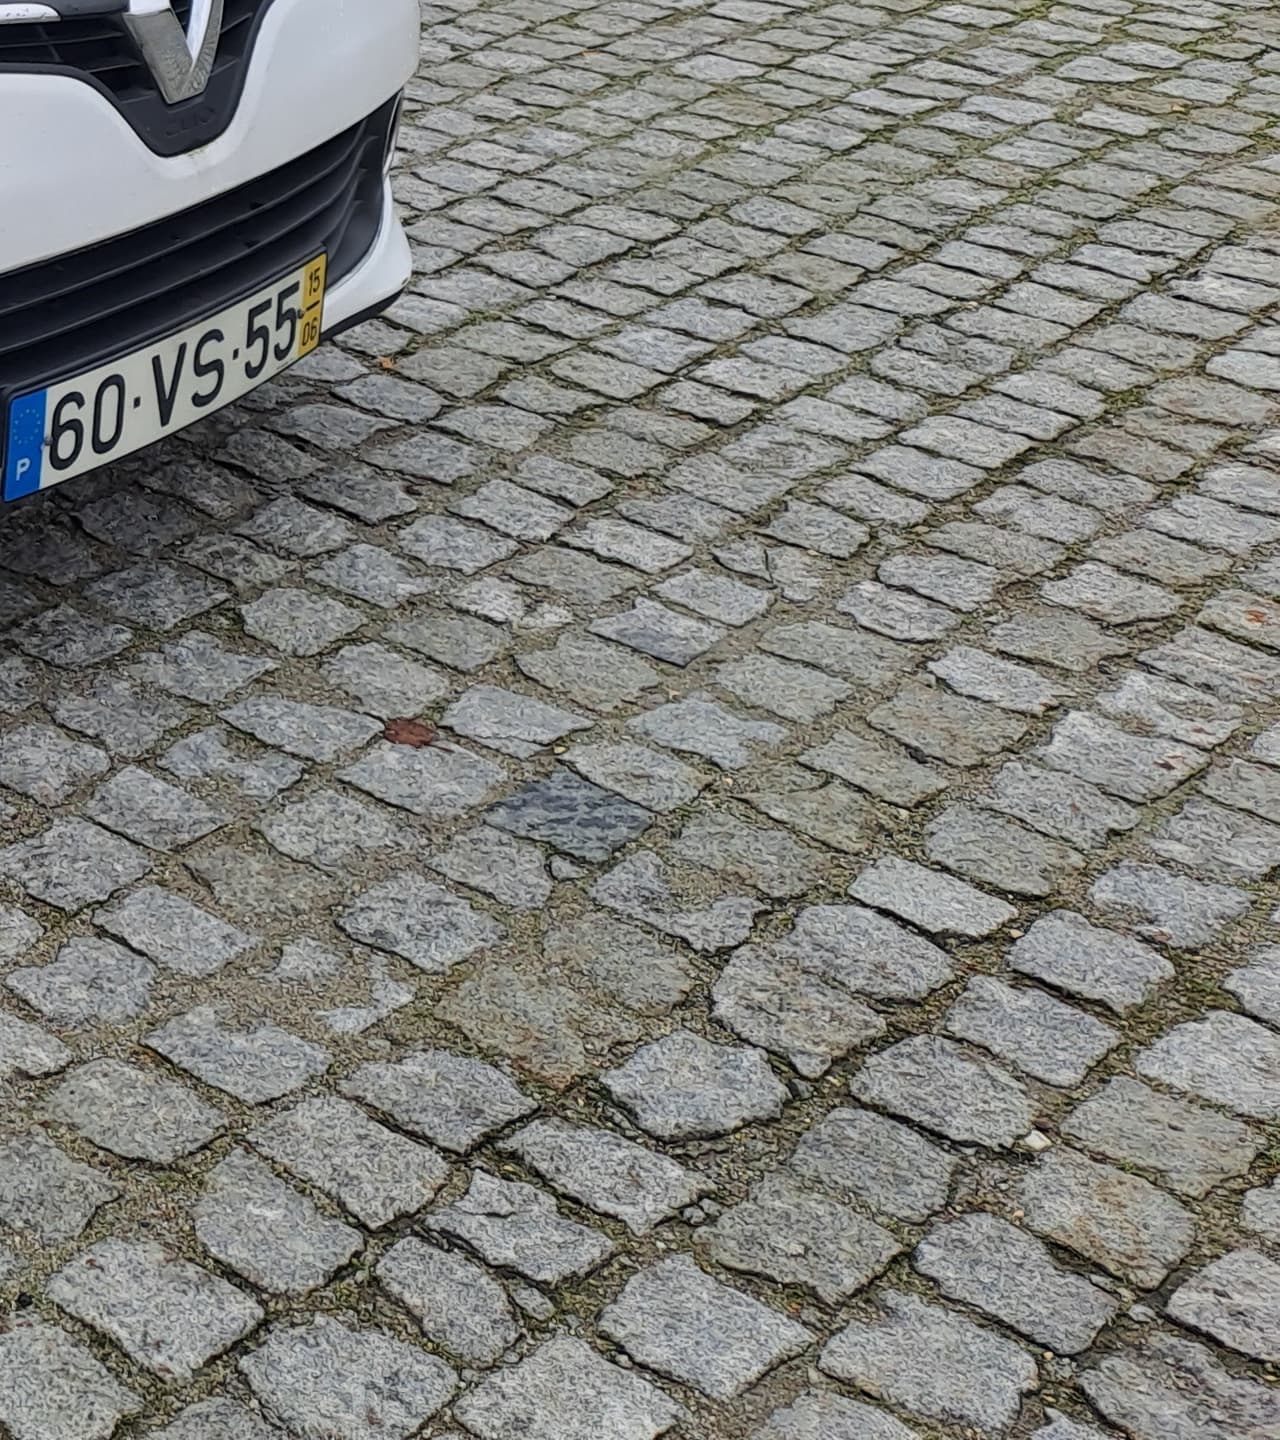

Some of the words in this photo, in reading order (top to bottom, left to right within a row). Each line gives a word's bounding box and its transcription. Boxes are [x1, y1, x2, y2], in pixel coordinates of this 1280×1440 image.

[308, 271, 320, 297] 15
[302, 316, 318, 347] 06
[15, 457, 31, 481] P
